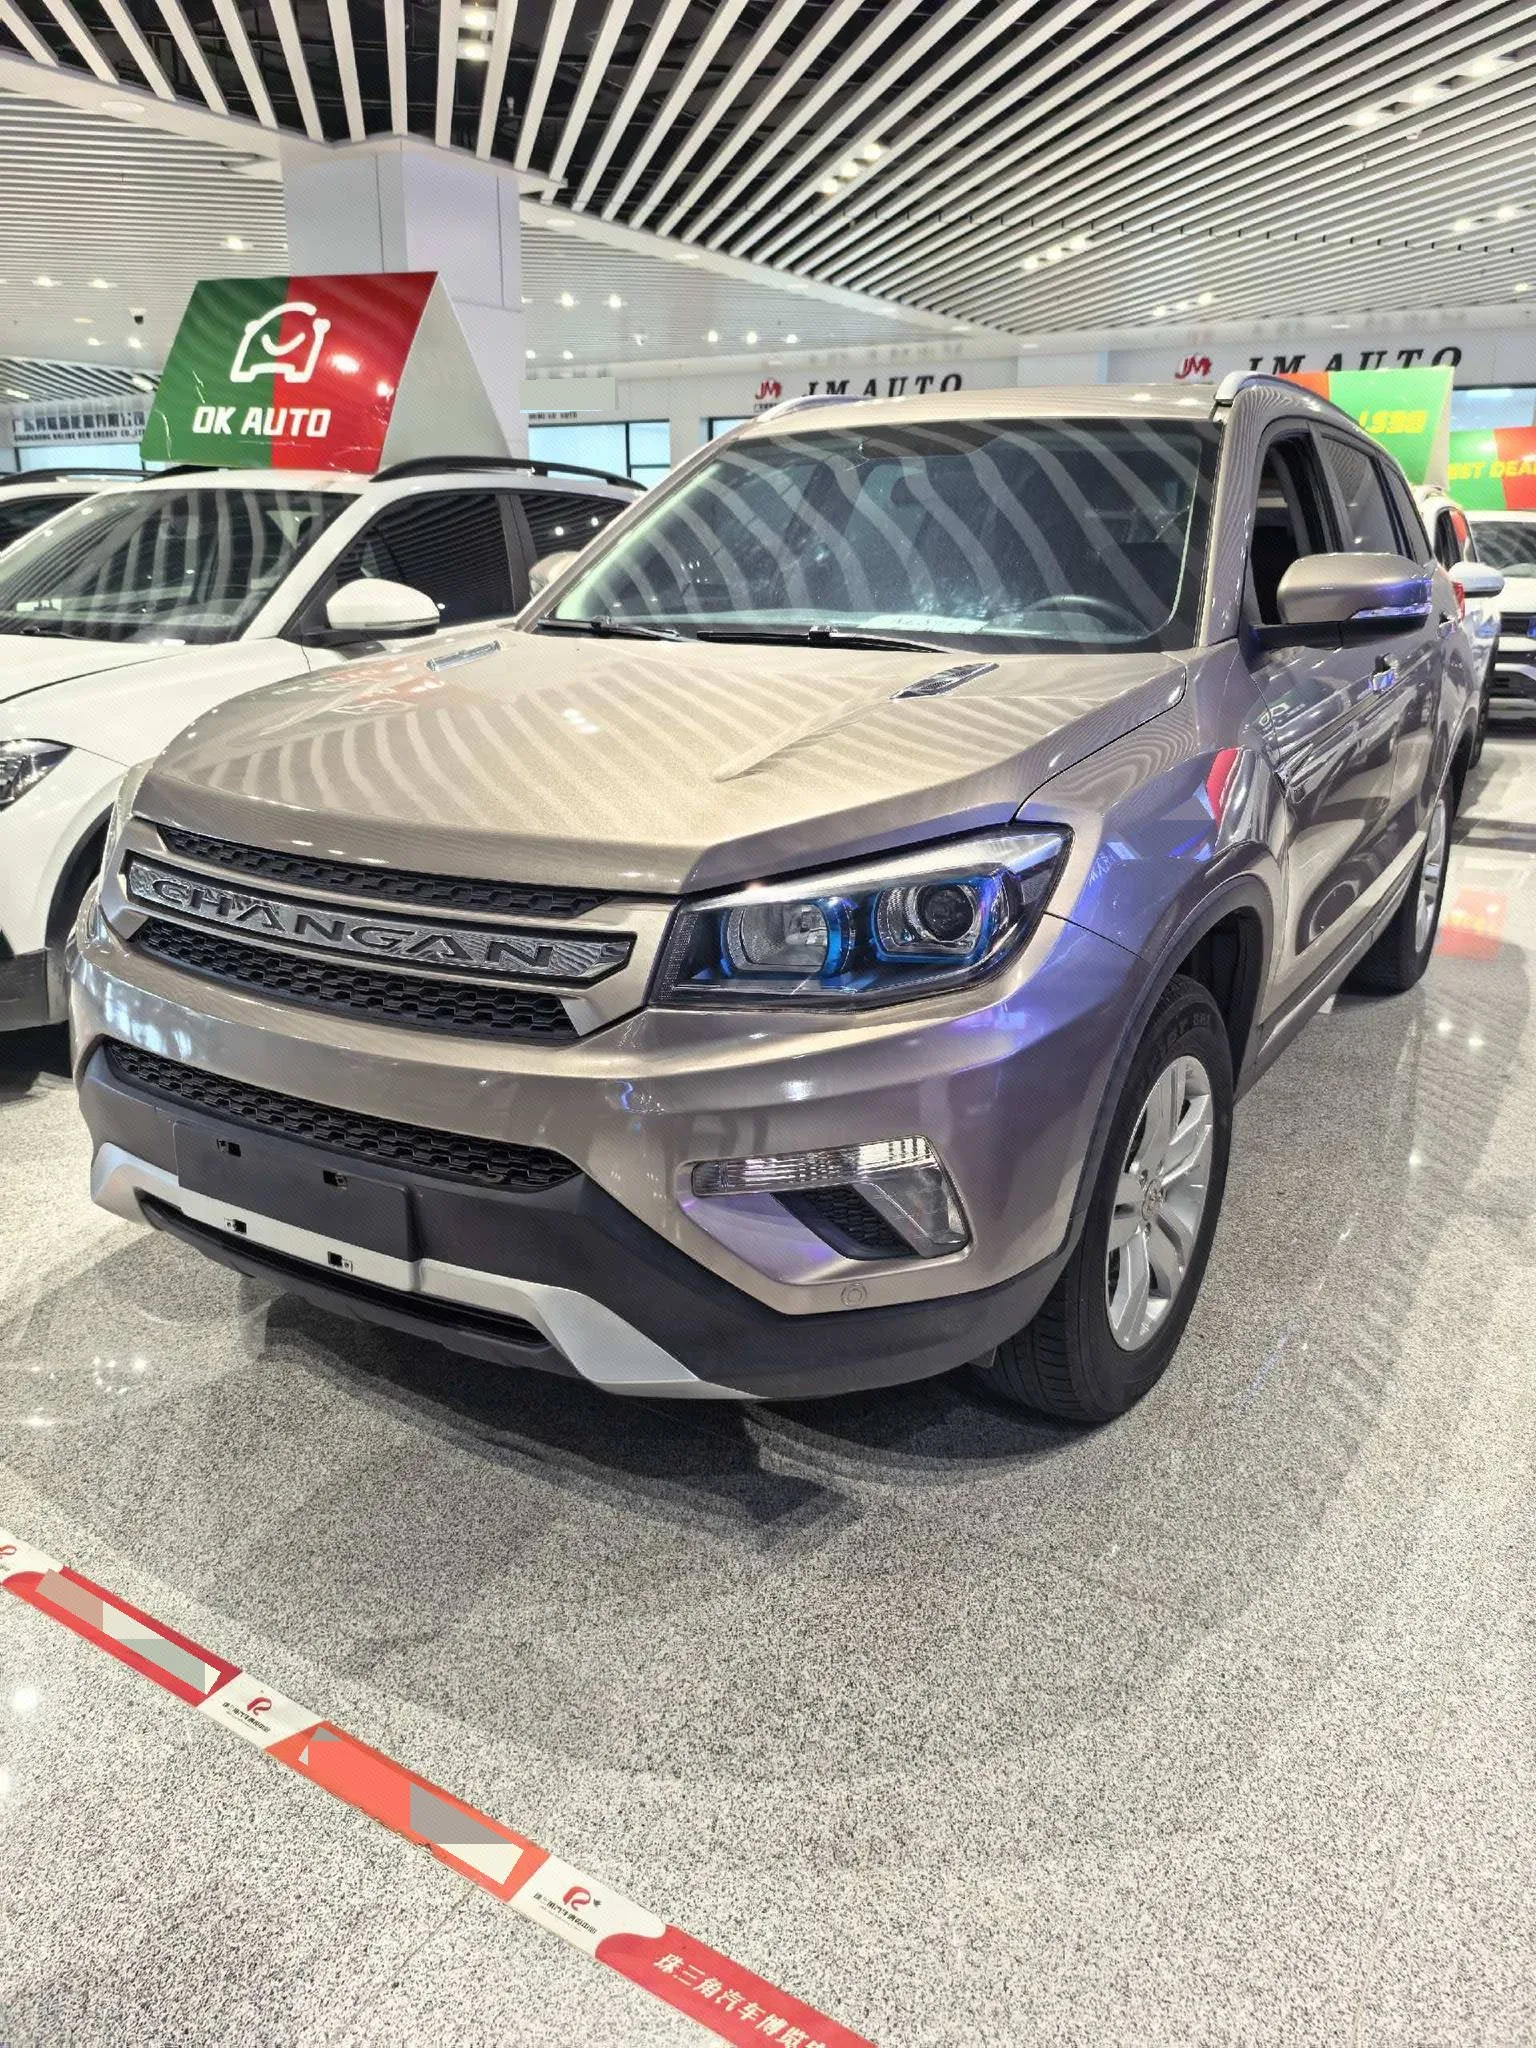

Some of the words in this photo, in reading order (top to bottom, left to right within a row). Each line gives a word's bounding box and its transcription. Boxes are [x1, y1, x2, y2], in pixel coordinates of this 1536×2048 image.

[1325, 346, 1463, 372] AUTO
[863, 373, 963, 398] AUTO
[192, 406, 237, 434] OK
[240, 407, 332, 437] AUTO
[152, 879, 555, 968] CHANGAN
[653, 1953, 827, 2048] 珠三角汽车博览
